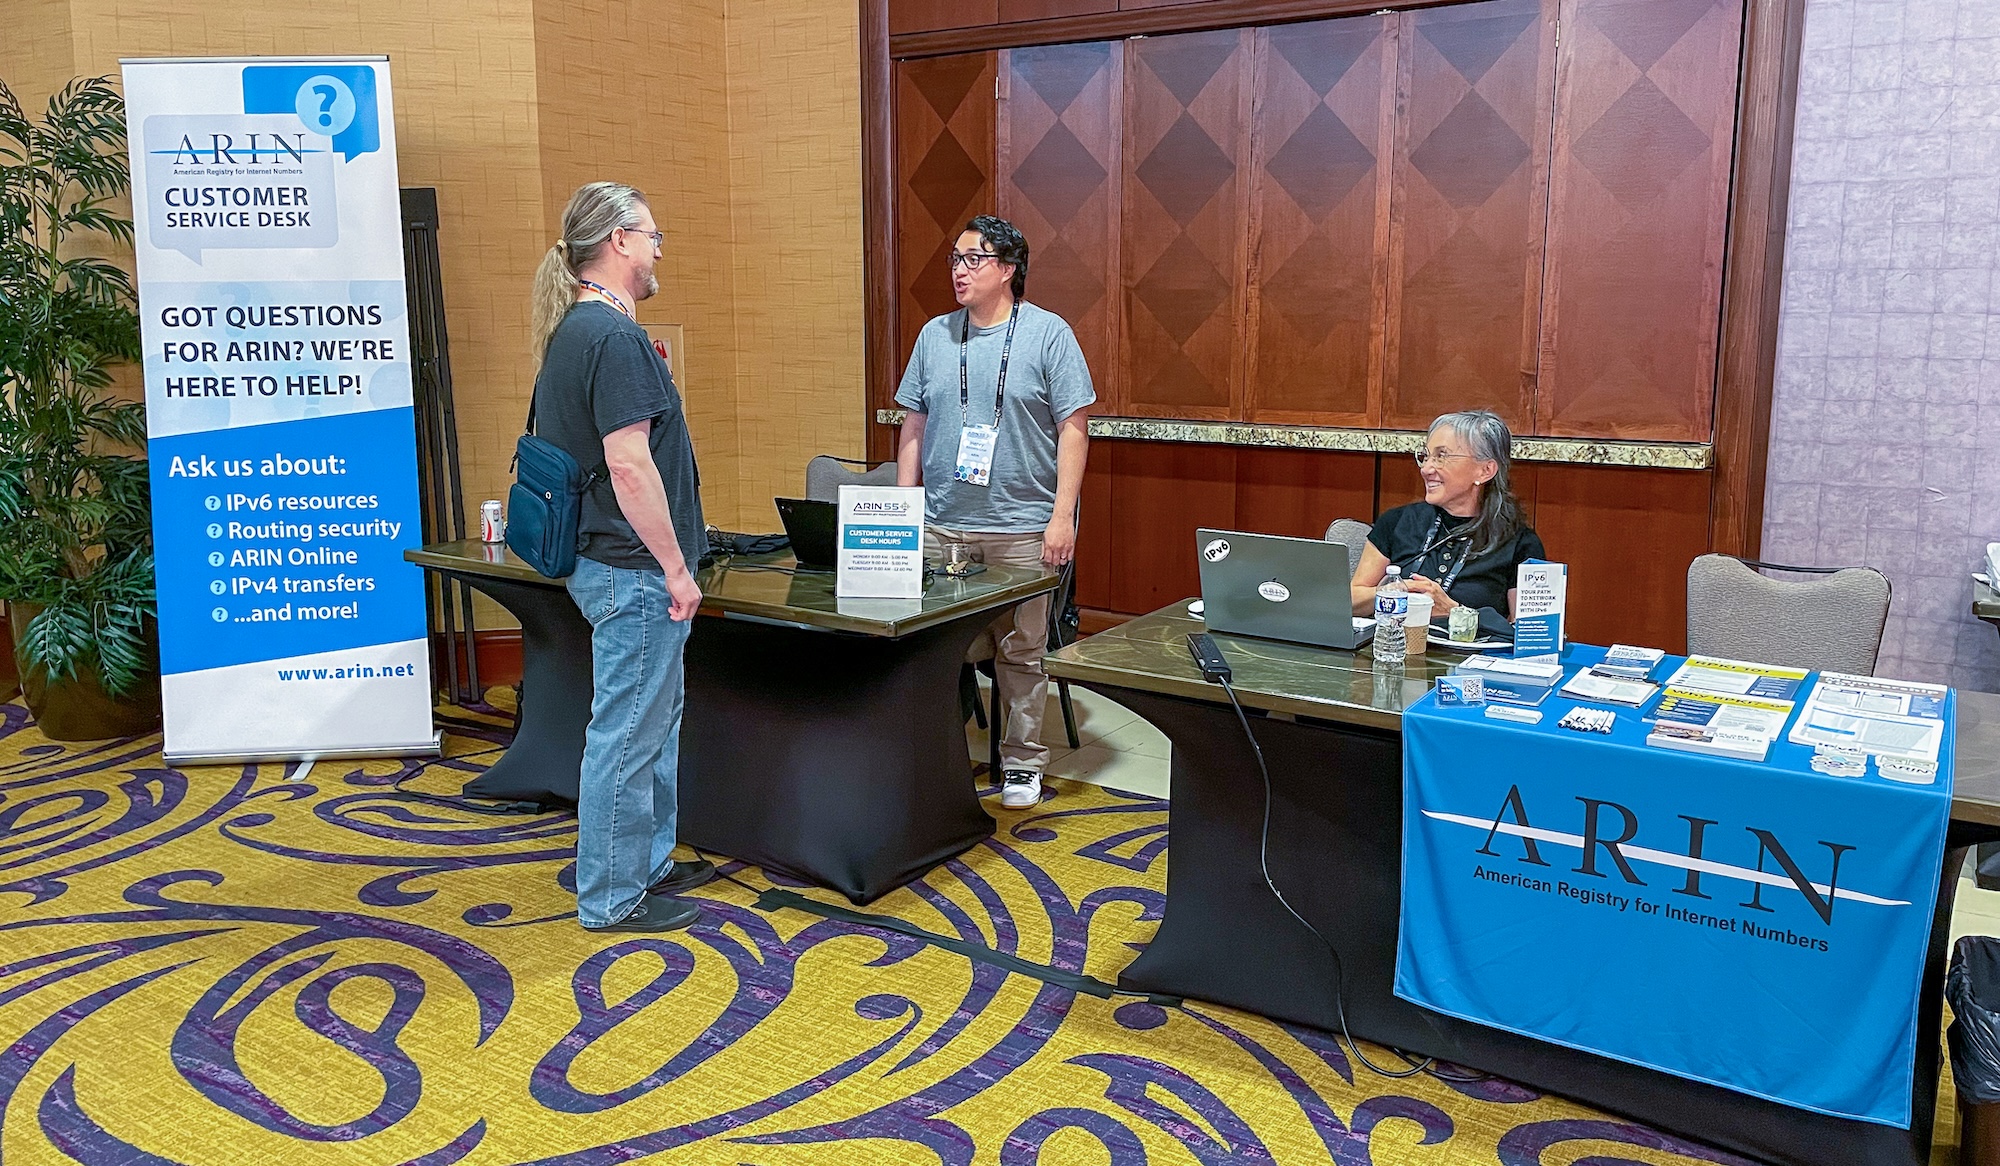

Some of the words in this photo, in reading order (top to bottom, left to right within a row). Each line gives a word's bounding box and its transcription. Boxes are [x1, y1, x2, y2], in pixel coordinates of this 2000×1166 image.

[173, 133, 306, 165] ARIN
[173, 168, 205, 176] American
[206, 168, 234, 177] Registry
[235, 168, 245, 176] for
[246, 168, 272, 176] Internet
[273, 167, 303, 175] Numbers
[165, 187, 309, 207] CUSTOMER
[166, 212, 250, 228] SERVICE
[257, 211, 311, 228] DESK
[161, 306, 218, 328] GOT
[226, 304, 382, 330] QUESTIONS
[164, 341, 220, 363] FOR
[226, 340, 304, 362] ARIN?
[310, 339, 394, 361] WE'RE
[166, 377, 237, 398] HERE
[241, 376, 278, 397] TO
[286, 375, 362, 396] HELP!
[168, 455, 218, 478] Ask
[223, 459, 253, 477] us
[260, 453, 347, 476] about:
[226, 494, 272, 512] IPv6
[278, 493, 379, 511] resources
[853, 502, 883, 511] ARIN
[884, 502, 900, 511] 55
[228, 521, 313, 542] Routing
[318, 518, 402, 540] security
[849, 529, 885, 537] CUSTOMER
[229, 549, 282, 567] ARIN
[287, 547, 358, 566] Online
[1205, 541, 1229, 560] IPv6
[231, 577, 278, 595] IPv4
[283, 575, 376, 593] transfers
[1524, 573, 1546, 583] IPv6
[233, 603, 292, 623] ...and
[297, 601, 359, 621] more!
[277, 662, 415, 682] www.arin.net
[1475, 783, 1857, 927] ARIN
[1473, 865, 1552, 893] American
[1557, 881, 1630, 912] Registry
[1635, 897, 1660, 915] for
[1665, 903, 1737, 932] Internet
[1742, 919, 1829, 952] Numbers
